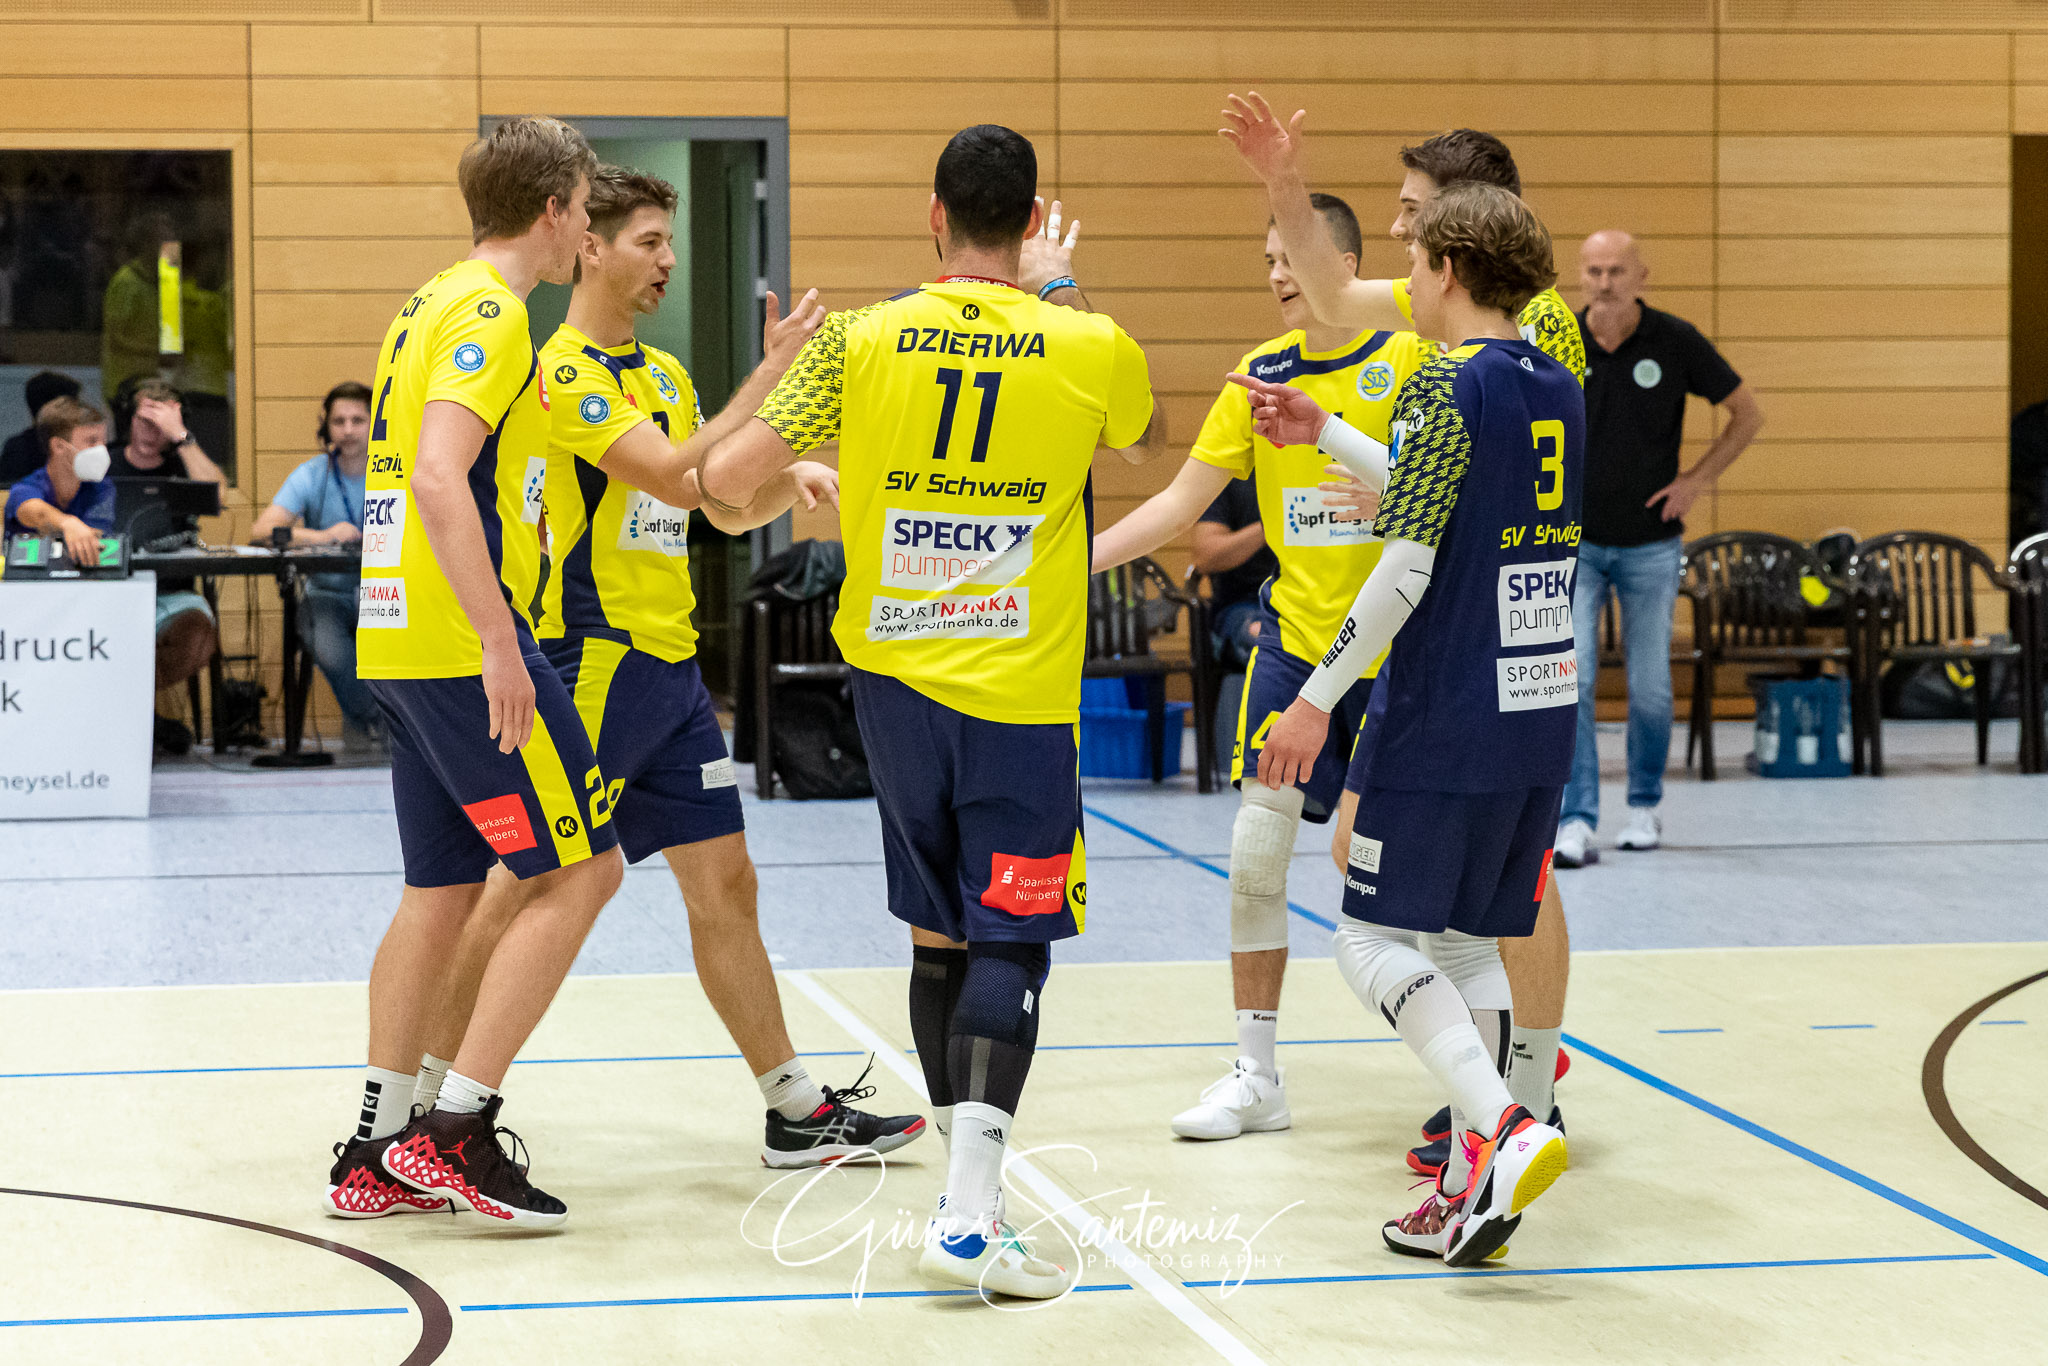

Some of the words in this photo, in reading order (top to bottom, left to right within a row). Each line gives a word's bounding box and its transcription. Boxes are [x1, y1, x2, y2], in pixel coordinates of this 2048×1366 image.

[896, 327, 1046, 358] DZIERWA
[1256, 359, 1293, 376] Kempa
[931, 367, 1003, 463] 11
[1530, 419, 1566, 511] 3
[884, 471, 920, 492] SV
[926, 473, 1047, 504] Schwaig
[17, 537, 40, 564] 1
[893, 518, 998, 553] SPECK
[1500, 526, 1527, 549] SV
[98, 538, 120, 566] 2
[880, 595, 1019, 621] SPORTNANKA
[0, 628, 110, 661] ruck
[584, 764, 612, 829] 2
[1345, 873, 1377, 896] Kempa
